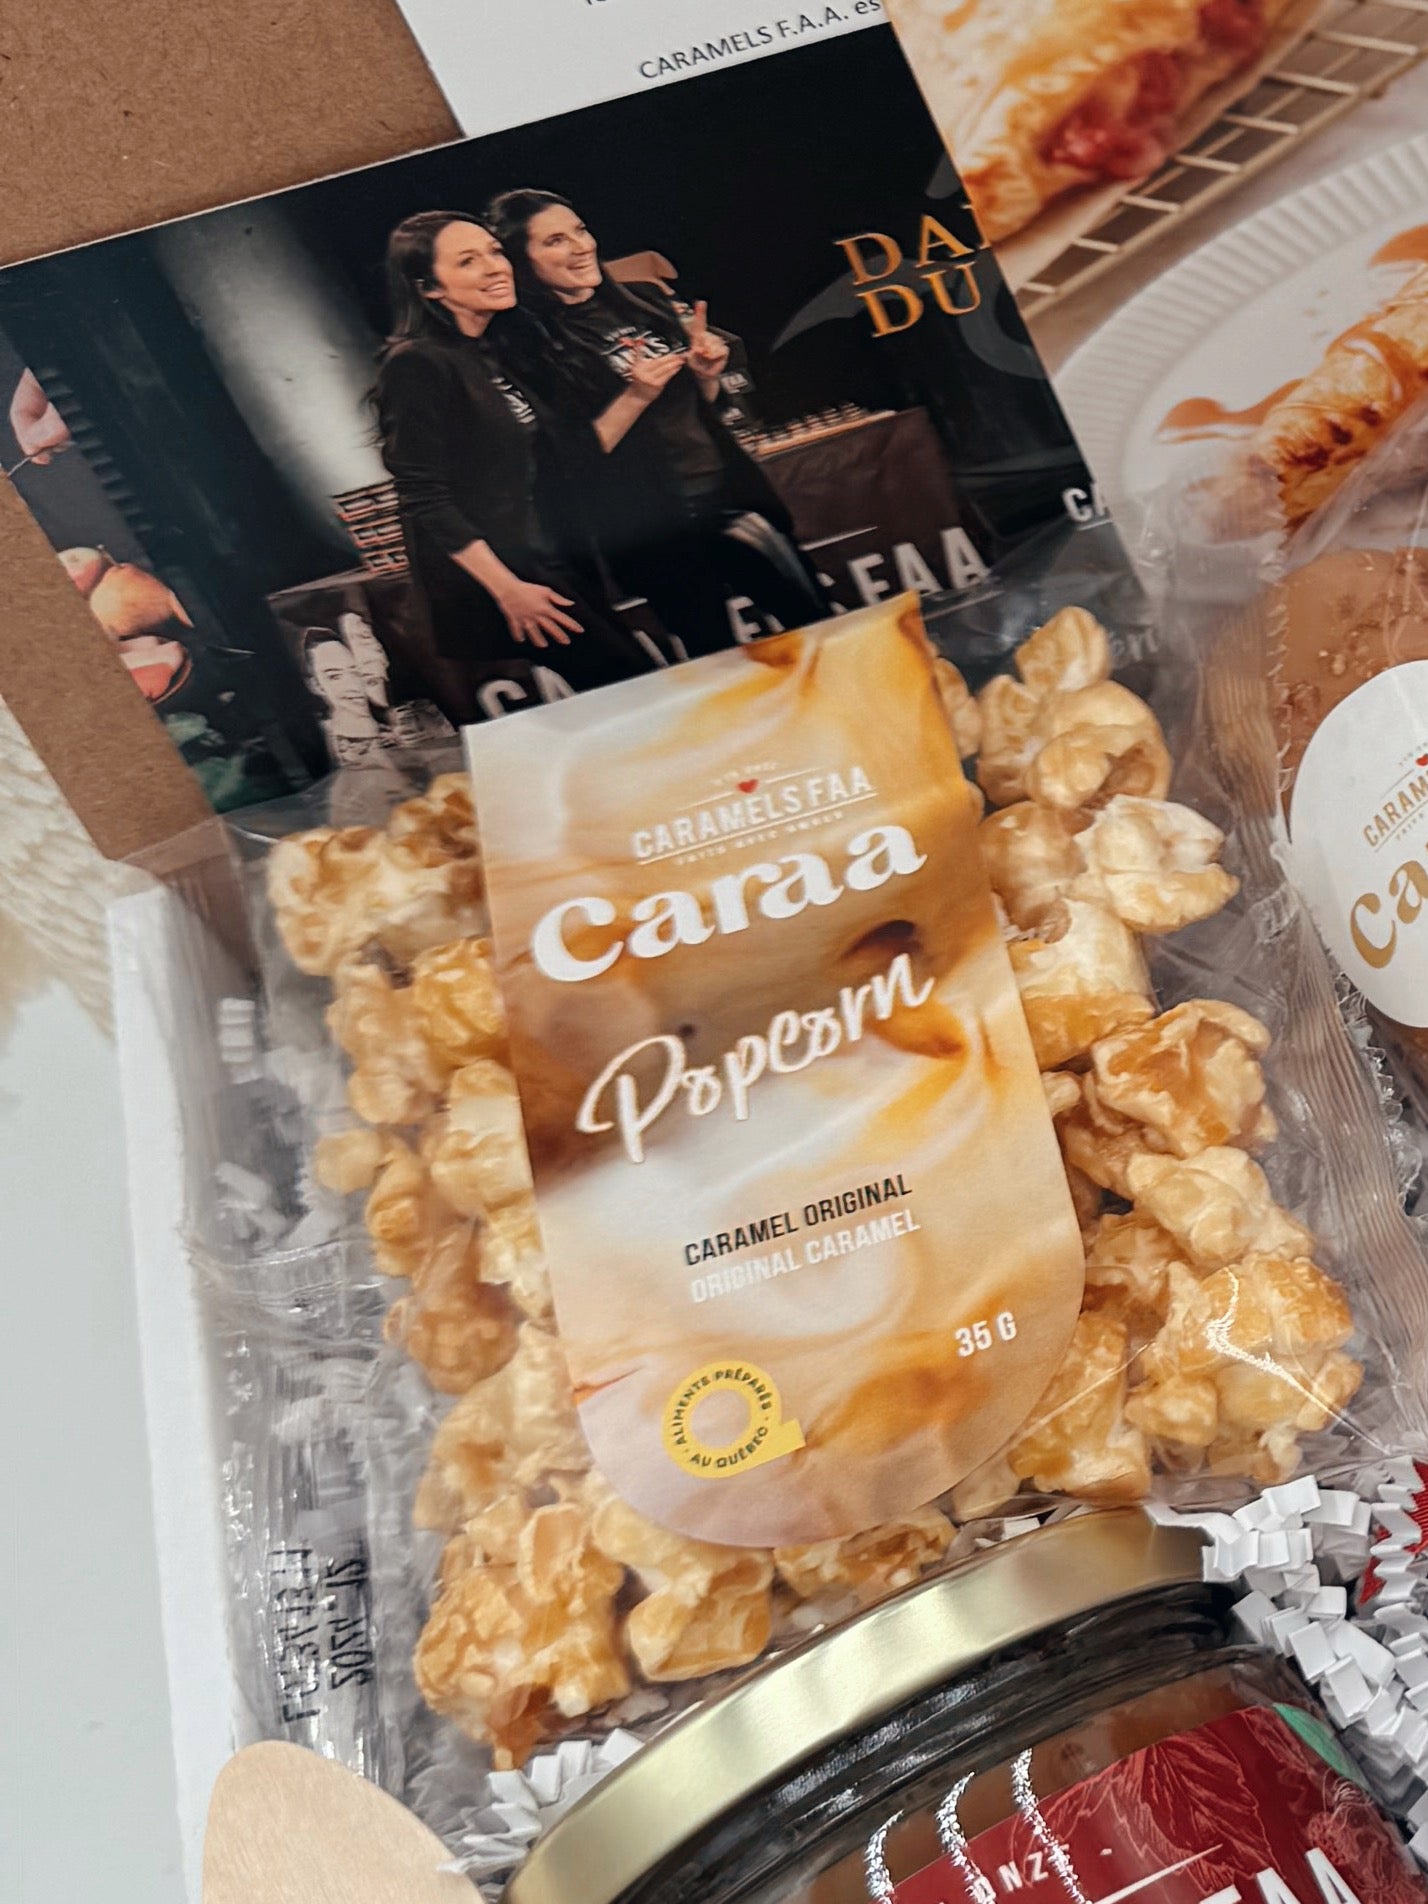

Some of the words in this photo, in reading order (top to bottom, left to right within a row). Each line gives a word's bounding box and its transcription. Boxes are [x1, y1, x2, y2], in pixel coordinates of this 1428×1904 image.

[856, 261, 982, 338] DU
[632, 784, 802, 858] CARAMELS
[576, 952, 936, 1163] Popcorn
[684, 1211, 798, 1267] CARAMEL
[803, 1173, 912, 1229] ORIGINAL
[690, 1251, 804, 1303] ORIGINAL
[805, 1209, 921, 1266] CARAMEL
[954, 1316, 994, 1358] 35
[996, 1310, 1018, 1343] G
[672, 1376, 711, 1446] ALIMENTS
[690, 1453, 712, 1467] AU
